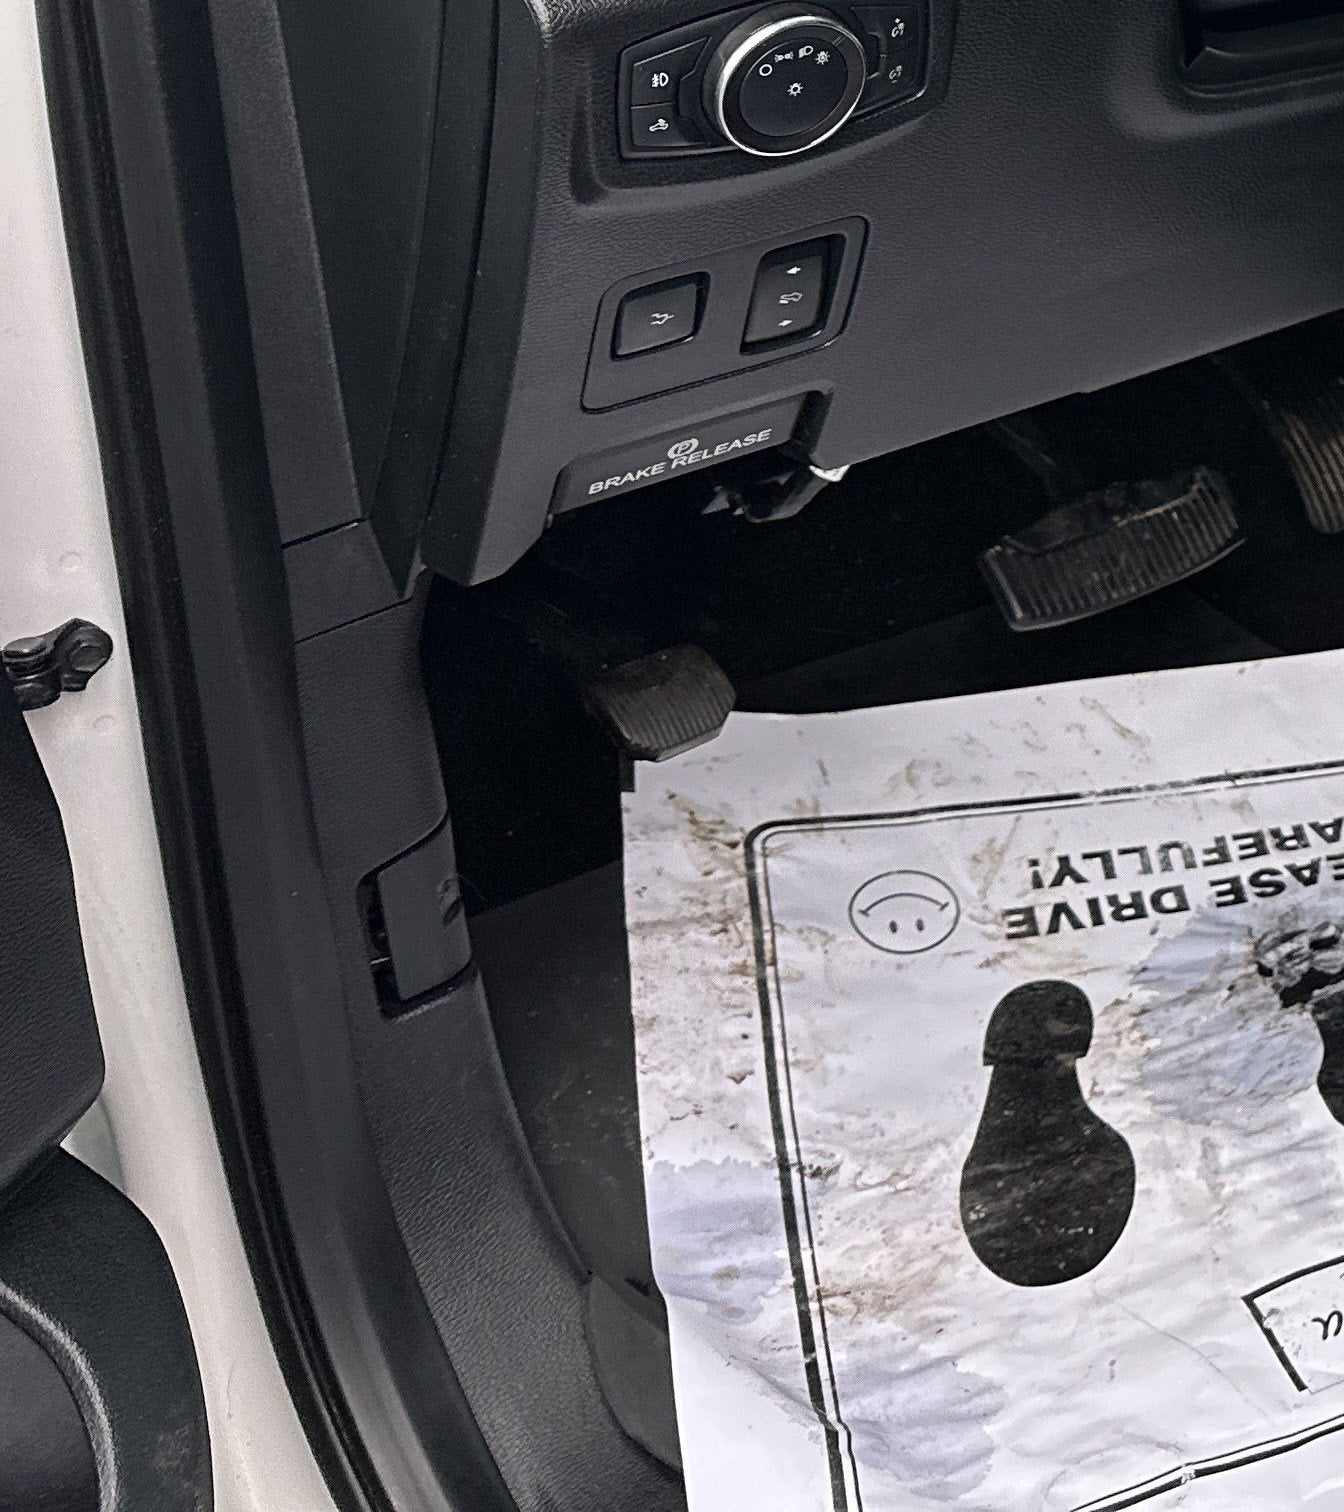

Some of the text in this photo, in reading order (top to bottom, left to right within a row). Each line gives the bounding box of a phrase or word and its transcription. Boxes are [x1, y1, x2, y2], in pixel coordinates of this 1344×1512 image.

[588, 428, 772, 495] BRAKE RELEASE
[1001, 884, 1190, 939] DRIVE
